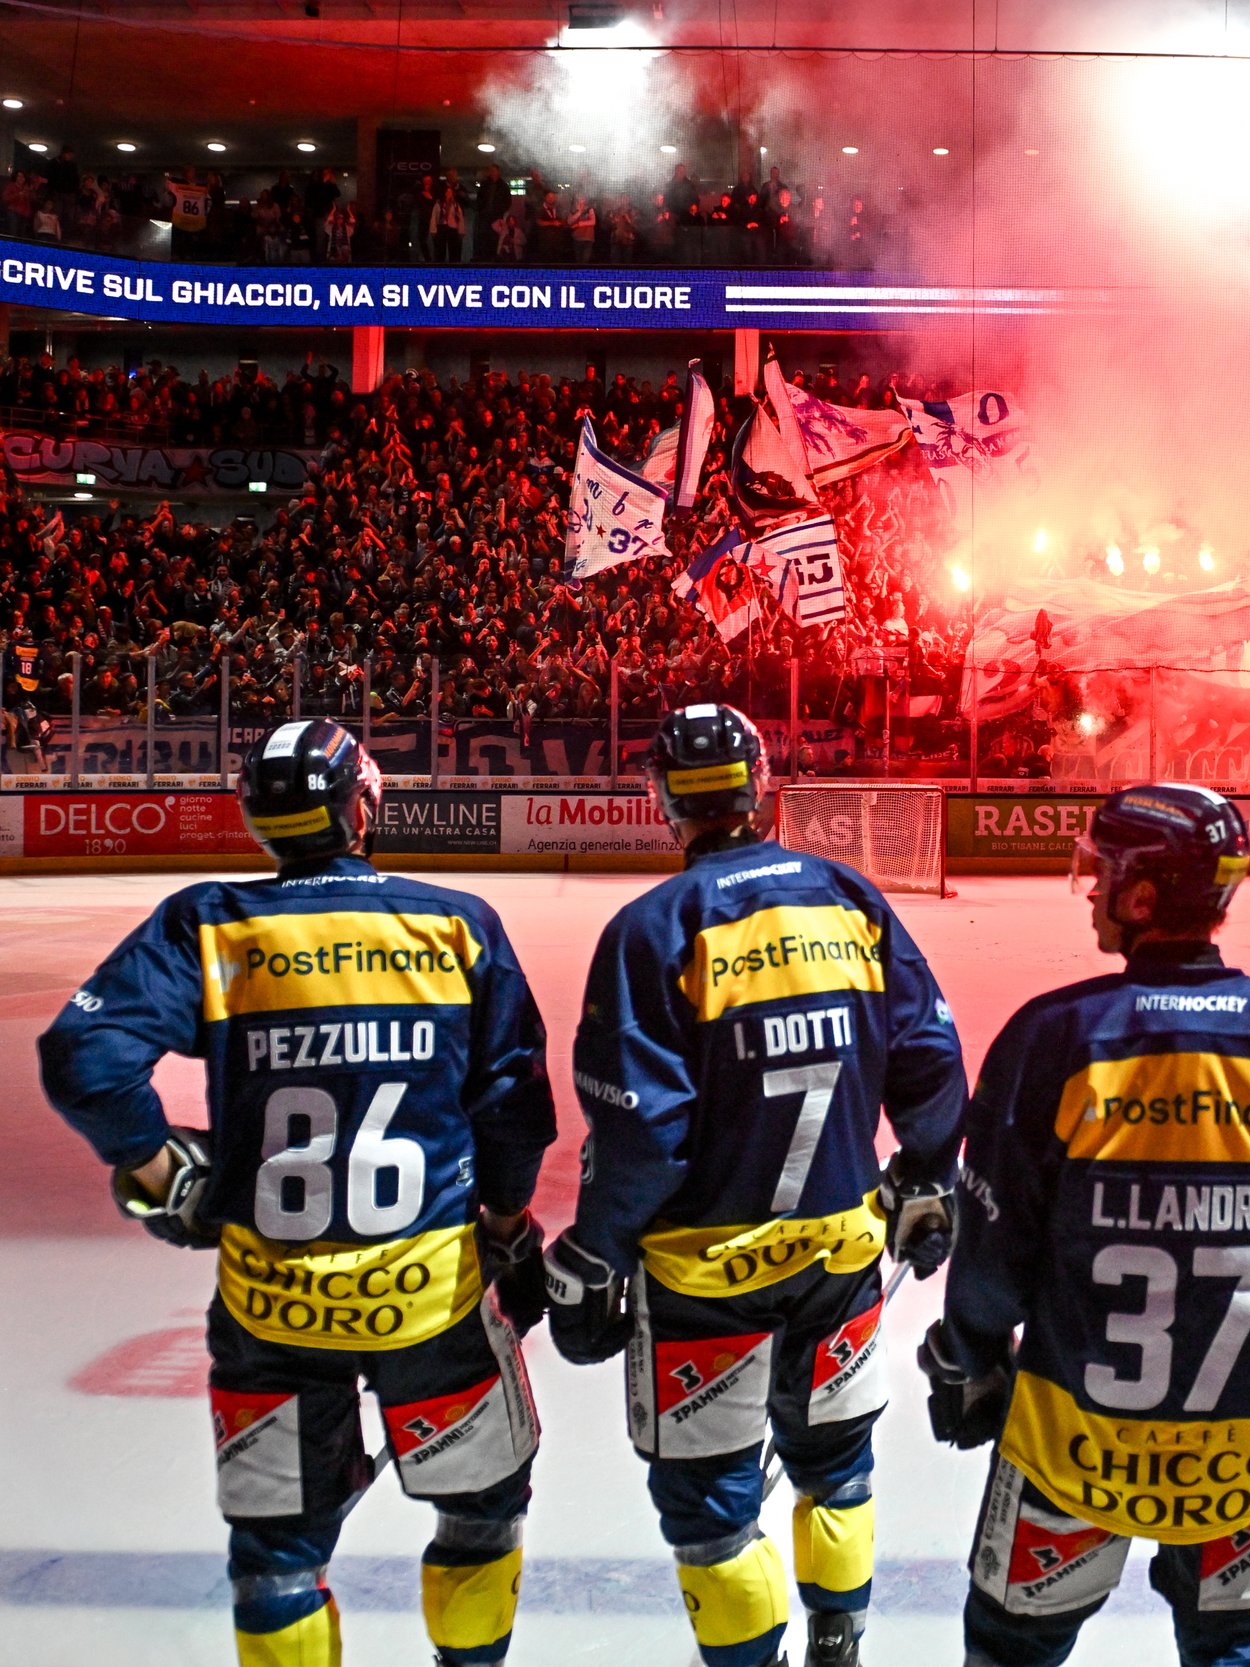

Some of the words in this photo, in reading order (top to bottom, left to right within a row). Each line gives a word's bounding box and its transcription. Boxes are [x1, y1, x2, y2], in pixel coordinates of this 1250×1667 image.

[182, 200, 199, 215] 86
[0, 258, 94, 294] CRIVE
[103, 273, 163, 303] SUL
[172, 281, 320, 310] GHIACCIO,
[329, 284, 374, 307] MA
[382, 284, 409, 308] SI
[417, 285, 482, 308] VIVE
[491, 285, 551, 308] CON
[561, 286, 585, 309] IL
[593, 286, 691, 309] CUORE
[1, 436, 173, 484] CURVA
[211, 450, 308, 487] SUD
[21, 661, 32, 675] 18
[732, 732, 741, 748] 7
[307, 774, 326, 791] 86
[180, 796, 212, 804] giorno
[526, 798, 552, 825] la
[180, 813, 212, 821] cucine
[403, 827, 461, 835] UN'ALTRA
[466, 827, 496, 835] CASA
[1205, 820, 1227, 844] 37
[528, 839, 576, 852] Agenzia
[580, 839, 632, 852] generale
[992, 842, 1008, 850] BIO
[1011, 842, 1046, 850] TISANE
[717, 862, 802, 889] INTERHOCKEY
[247, 941, 462, 980] PostFinanc
[1135, 995, 1248, 1014] INTERHOCKEY
[247, 1020, 436, 1072] PEZZULLO
[734, 1022, 756, 1061] I.
[764, 1006, 852, 1057] DOTTI
[763, 1061, 843, 1213] 7
[254, 1081, 426, 1241] 86
[239, 1250, 431, 1300] CHICCO
[671, 1380, 729, 1424] SPAHNI
[413, 1427, 467, 1466] SPAHNI
